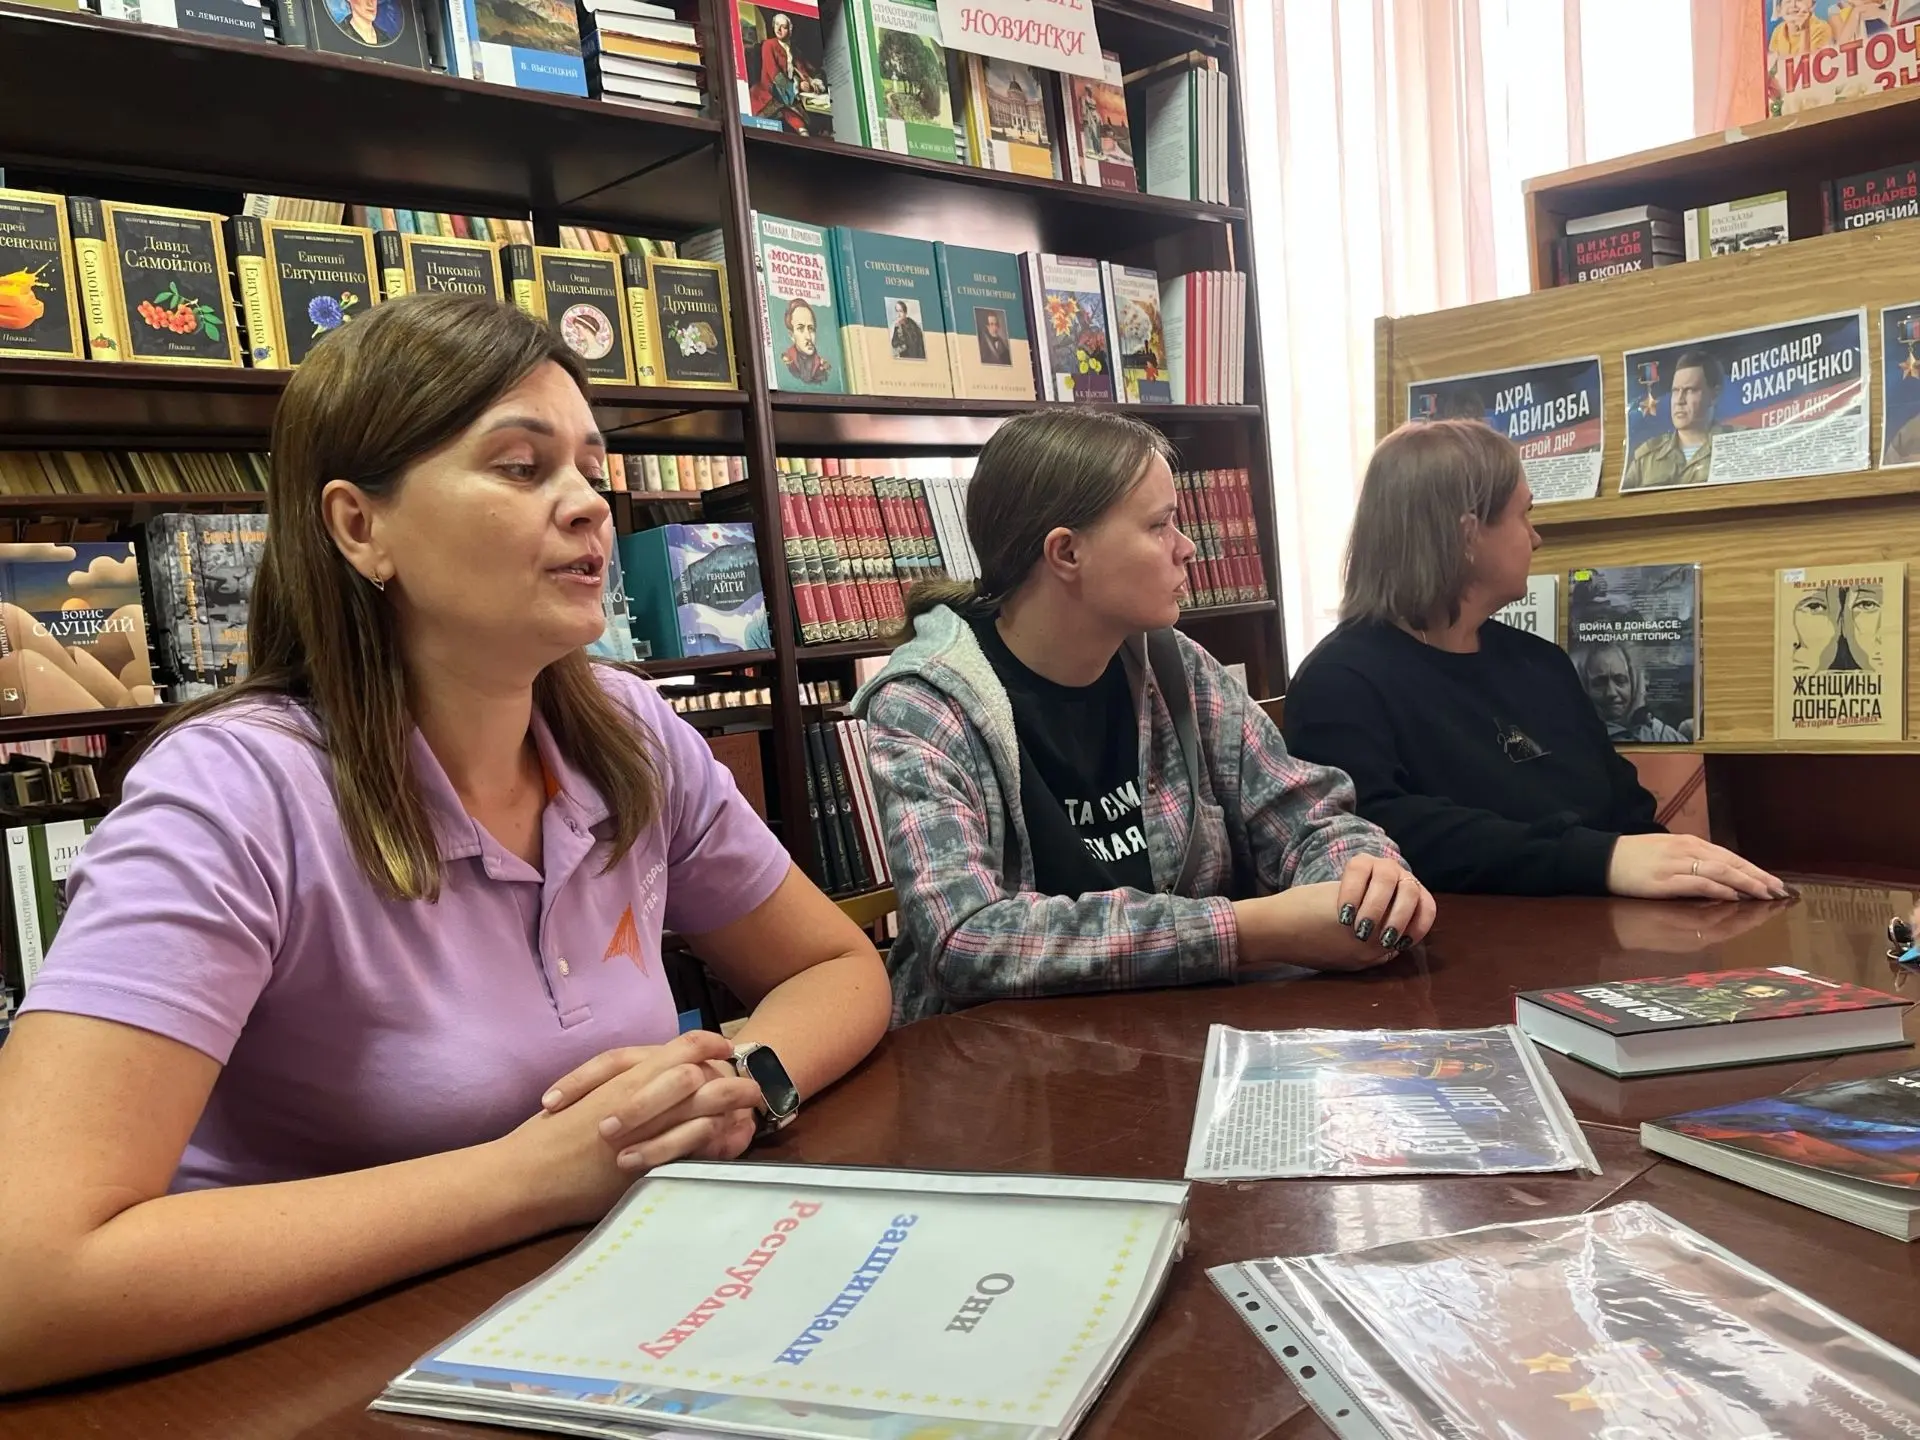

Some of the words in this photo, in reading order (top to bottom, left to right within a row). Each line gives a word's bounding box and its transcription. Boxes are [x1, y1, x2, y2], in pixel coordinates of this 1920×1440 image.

[198, 12, 256, 30] ЛЕВИТАНСКИЙ
[961, 8, 1086, 57] НОВИНКИ
[1844, 186, 1918, 211] БОНДАРЕВ
[1845, 200, 1919, 230] ГОРЯЧИЙ
[143, 236, 191, 254] Давид
[1576, 231, 1641, 254] ВИКТОР
[124, 249, 213, 274] Самойлов
[298, 251, 345, 266] Евгений
[1577, 243, 1641, 266] НЕКРАСОВ
[280, 262, 366, 284] Евтушенко
[427, 262, 481, 278] Николай
[864, 259, 930, 276] СТИХОТВОРЕНИЯ
[1578, 271, 1587, 283] В
[1590, 260, 1642, 280] ОКОПАХ
[84, 249, 103, 325] Самойлов
[426, 274, 487, 296] Рубцов
[547, 279, 616, 297] Мандельштам
[673, 284, 704, 297] Юлия
[885, 276, 914, 288] ПОЭМЫ
[245, 267, 266, 345] Евтушенко
[663, 295, 718, 314] Друнина
[1731, 333, 1822, 383] АЛЕКСАНДР
[1741, 348, 1853, 405] ЗАХАРЧЕНКО
[1495, 382, 1534, 415] АХРА
[1508, 390, 1590, 438] АВИДЗБА
[1519, 441, 1551, 461] ГЕРОЙ
[1553, 431, 1576, 452] ДНР
[706, 570, 746, 582] ГЕННАДИЙ
[712, 582, 745, 594] АЙГИ
[32, 616, 136, 637] СЛУЦКИЙ
[62, 609, 105, 621] БОРИС
[1579, 621, 1613, 632] ВОЙНА
[1615, 622, 1622, 631] В
[1624, 619, 1682, 631] ДОНБАССЕ:
[1579, 633, 1629, 643] НАРОДНАЯ
[1631, 631, 1681, 641] ЛЕТОПИСЬ
[1793, 674, 1882, 698] ЖЕНЩИНЫ
[1792, 698, 1882, 722] ДОНБАССА
[1064, 798, 1095, 826] ТА
[1100, 776, 1141, 822] САМ
[637, 1199, 823, 1361] Республику
[773, 1213, 919, 1367] защищали
[946, 1271, 1015, 1335] Они
